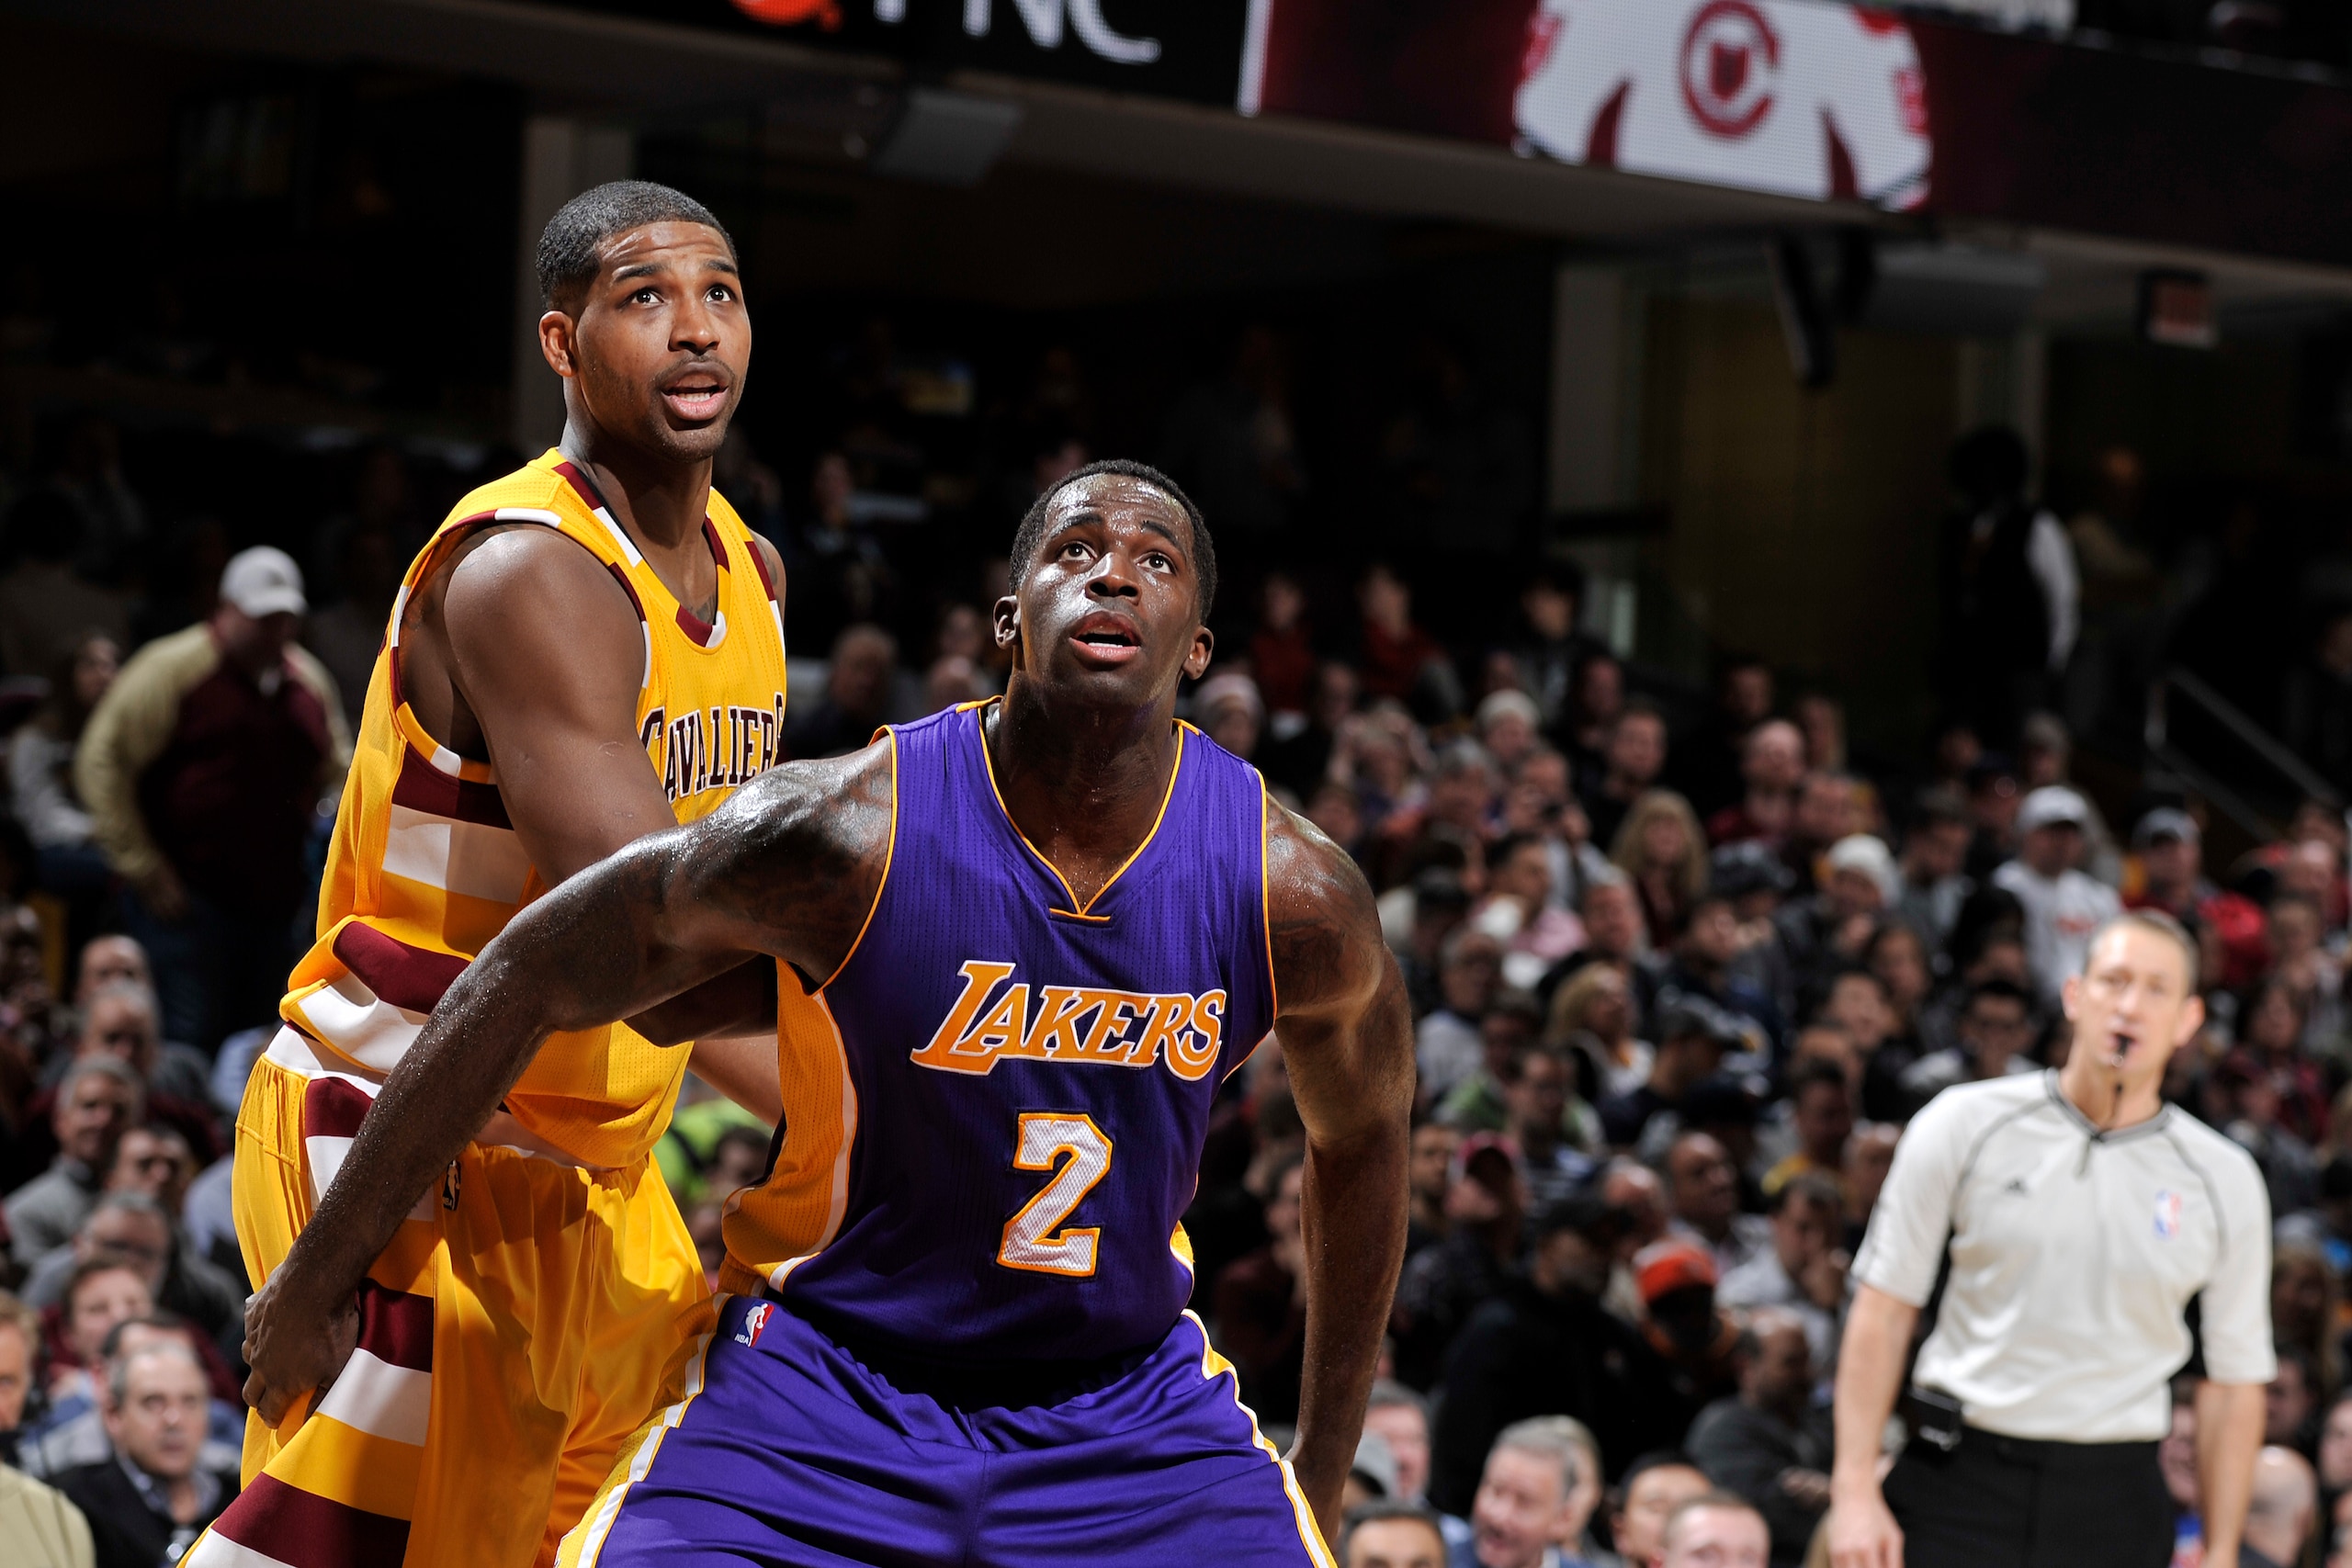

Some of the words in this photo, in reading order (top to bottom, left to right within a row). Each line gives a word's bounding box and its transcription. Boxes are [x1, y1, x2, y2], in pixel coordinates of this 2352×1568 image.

[910, 960, 1227, 1081] LAKERS
[995, 1111, 1114, 1278] 2
[734, 1334, 750, 1345] NBA
